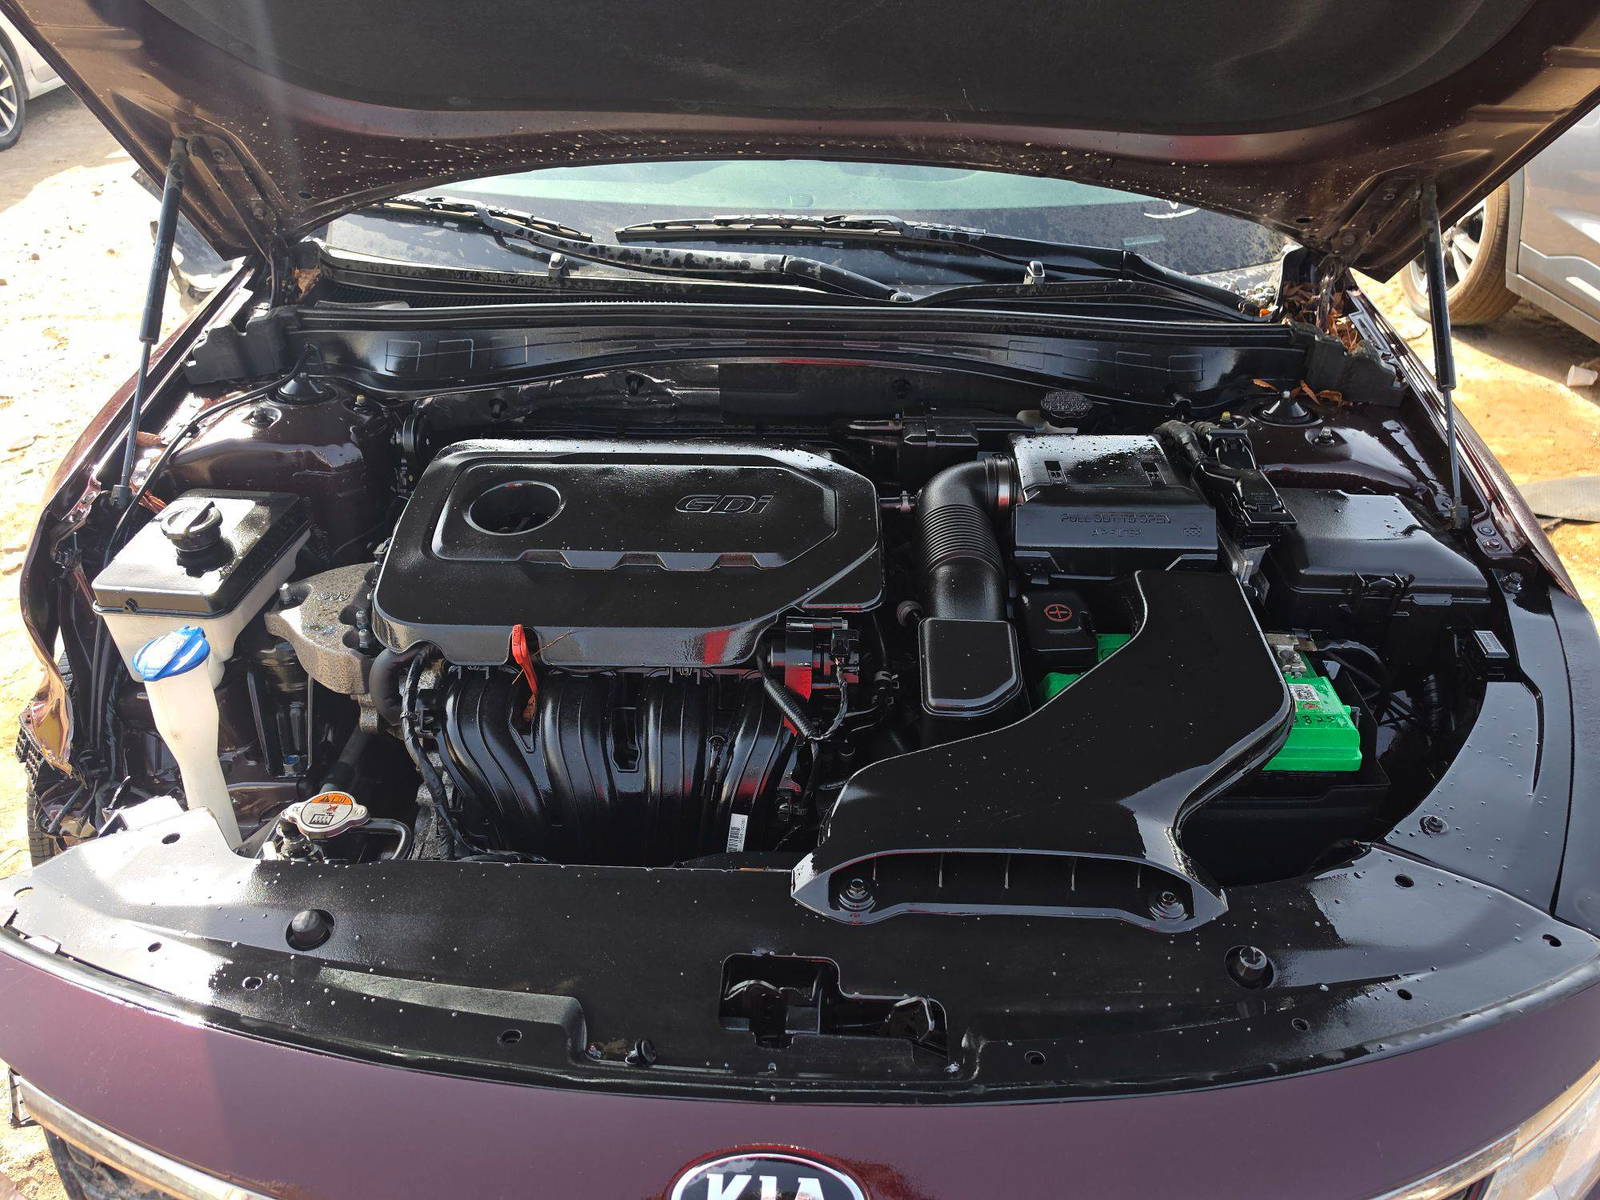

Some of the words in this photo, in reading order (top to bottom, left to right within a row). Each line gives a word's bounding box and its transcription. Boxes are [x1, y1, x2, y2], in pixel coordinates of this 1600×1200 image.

[675, 494, 774, 514] GDi
[1060, 513, 1091, 523] PULL
[1094, 512, 1117, 523] OUT
[1122, 512, 1137, 523] TO
[1140, 512, 1172, 524] OPEN
[706, 1173, 825, 1200] KIA
